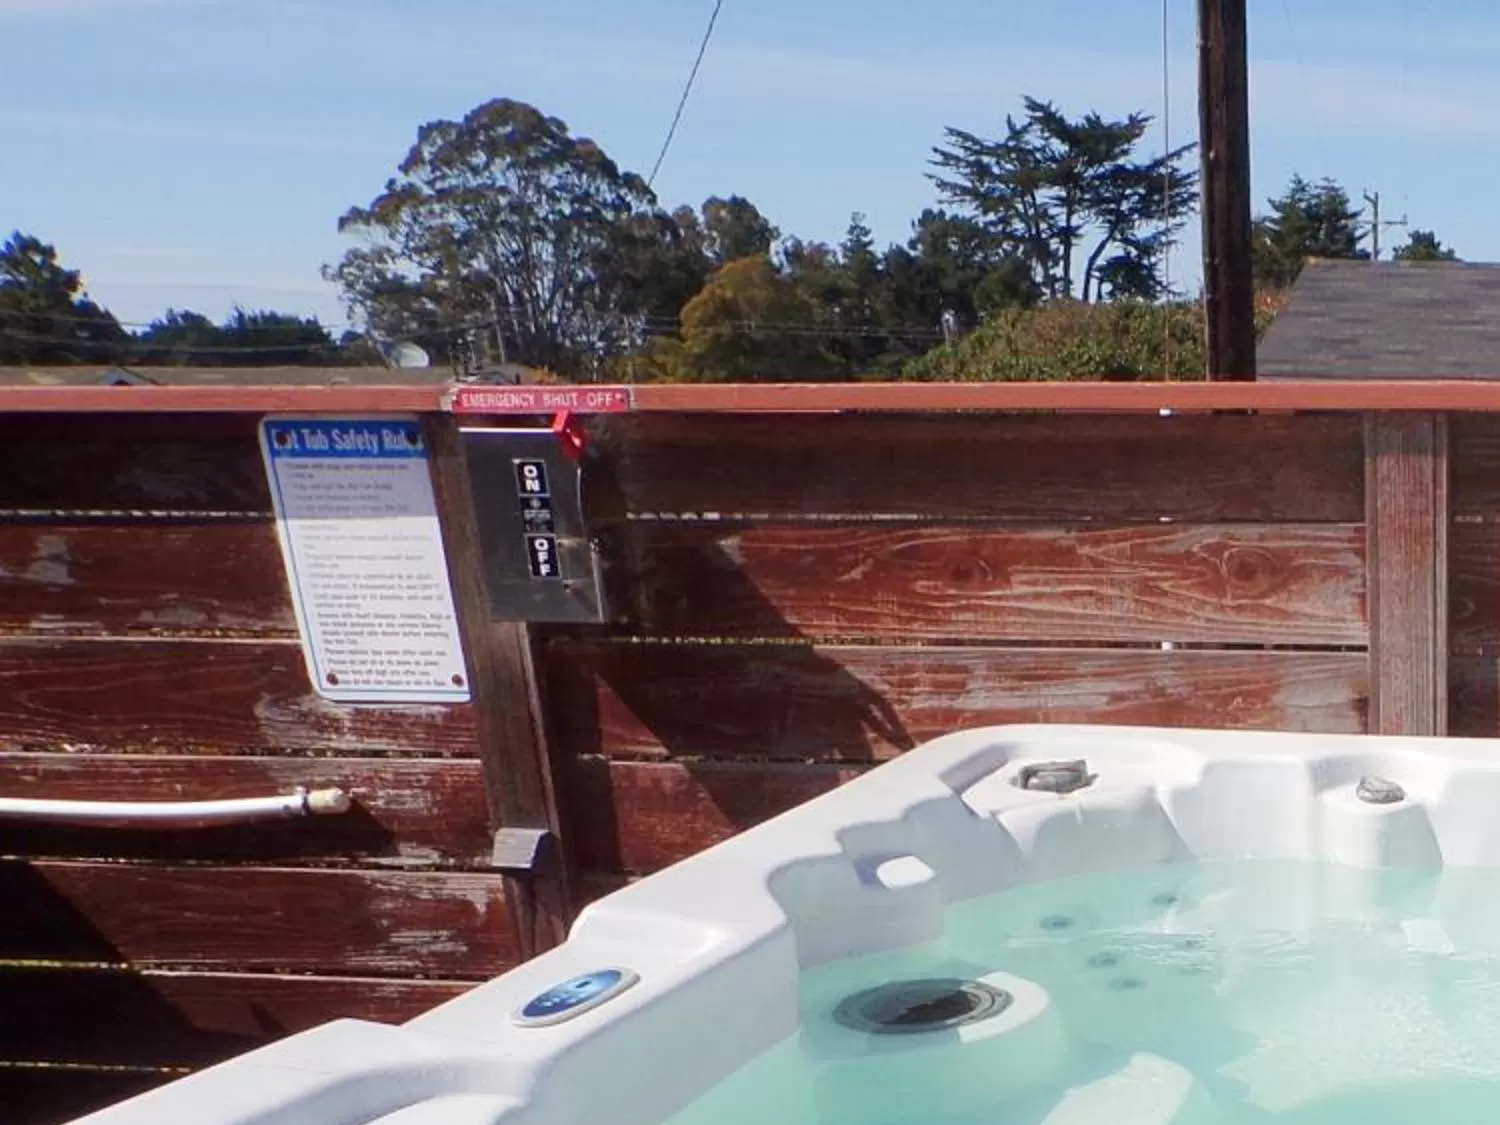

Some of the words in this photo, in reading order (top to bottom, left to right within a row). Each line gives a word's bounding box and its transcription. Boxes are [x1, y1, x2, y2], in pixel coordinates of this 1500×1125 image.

[462, 392, 535, 409] EMERGENCY
[543, 392, 578, 407] SHUT
[586, 391, 613, 407] OFF
[300, 428, 329, 449] Tub
[331, 428, 379, 454] Safety
[523, 464, 541, 493] ON
[533, 538, 551, 577] OFF
